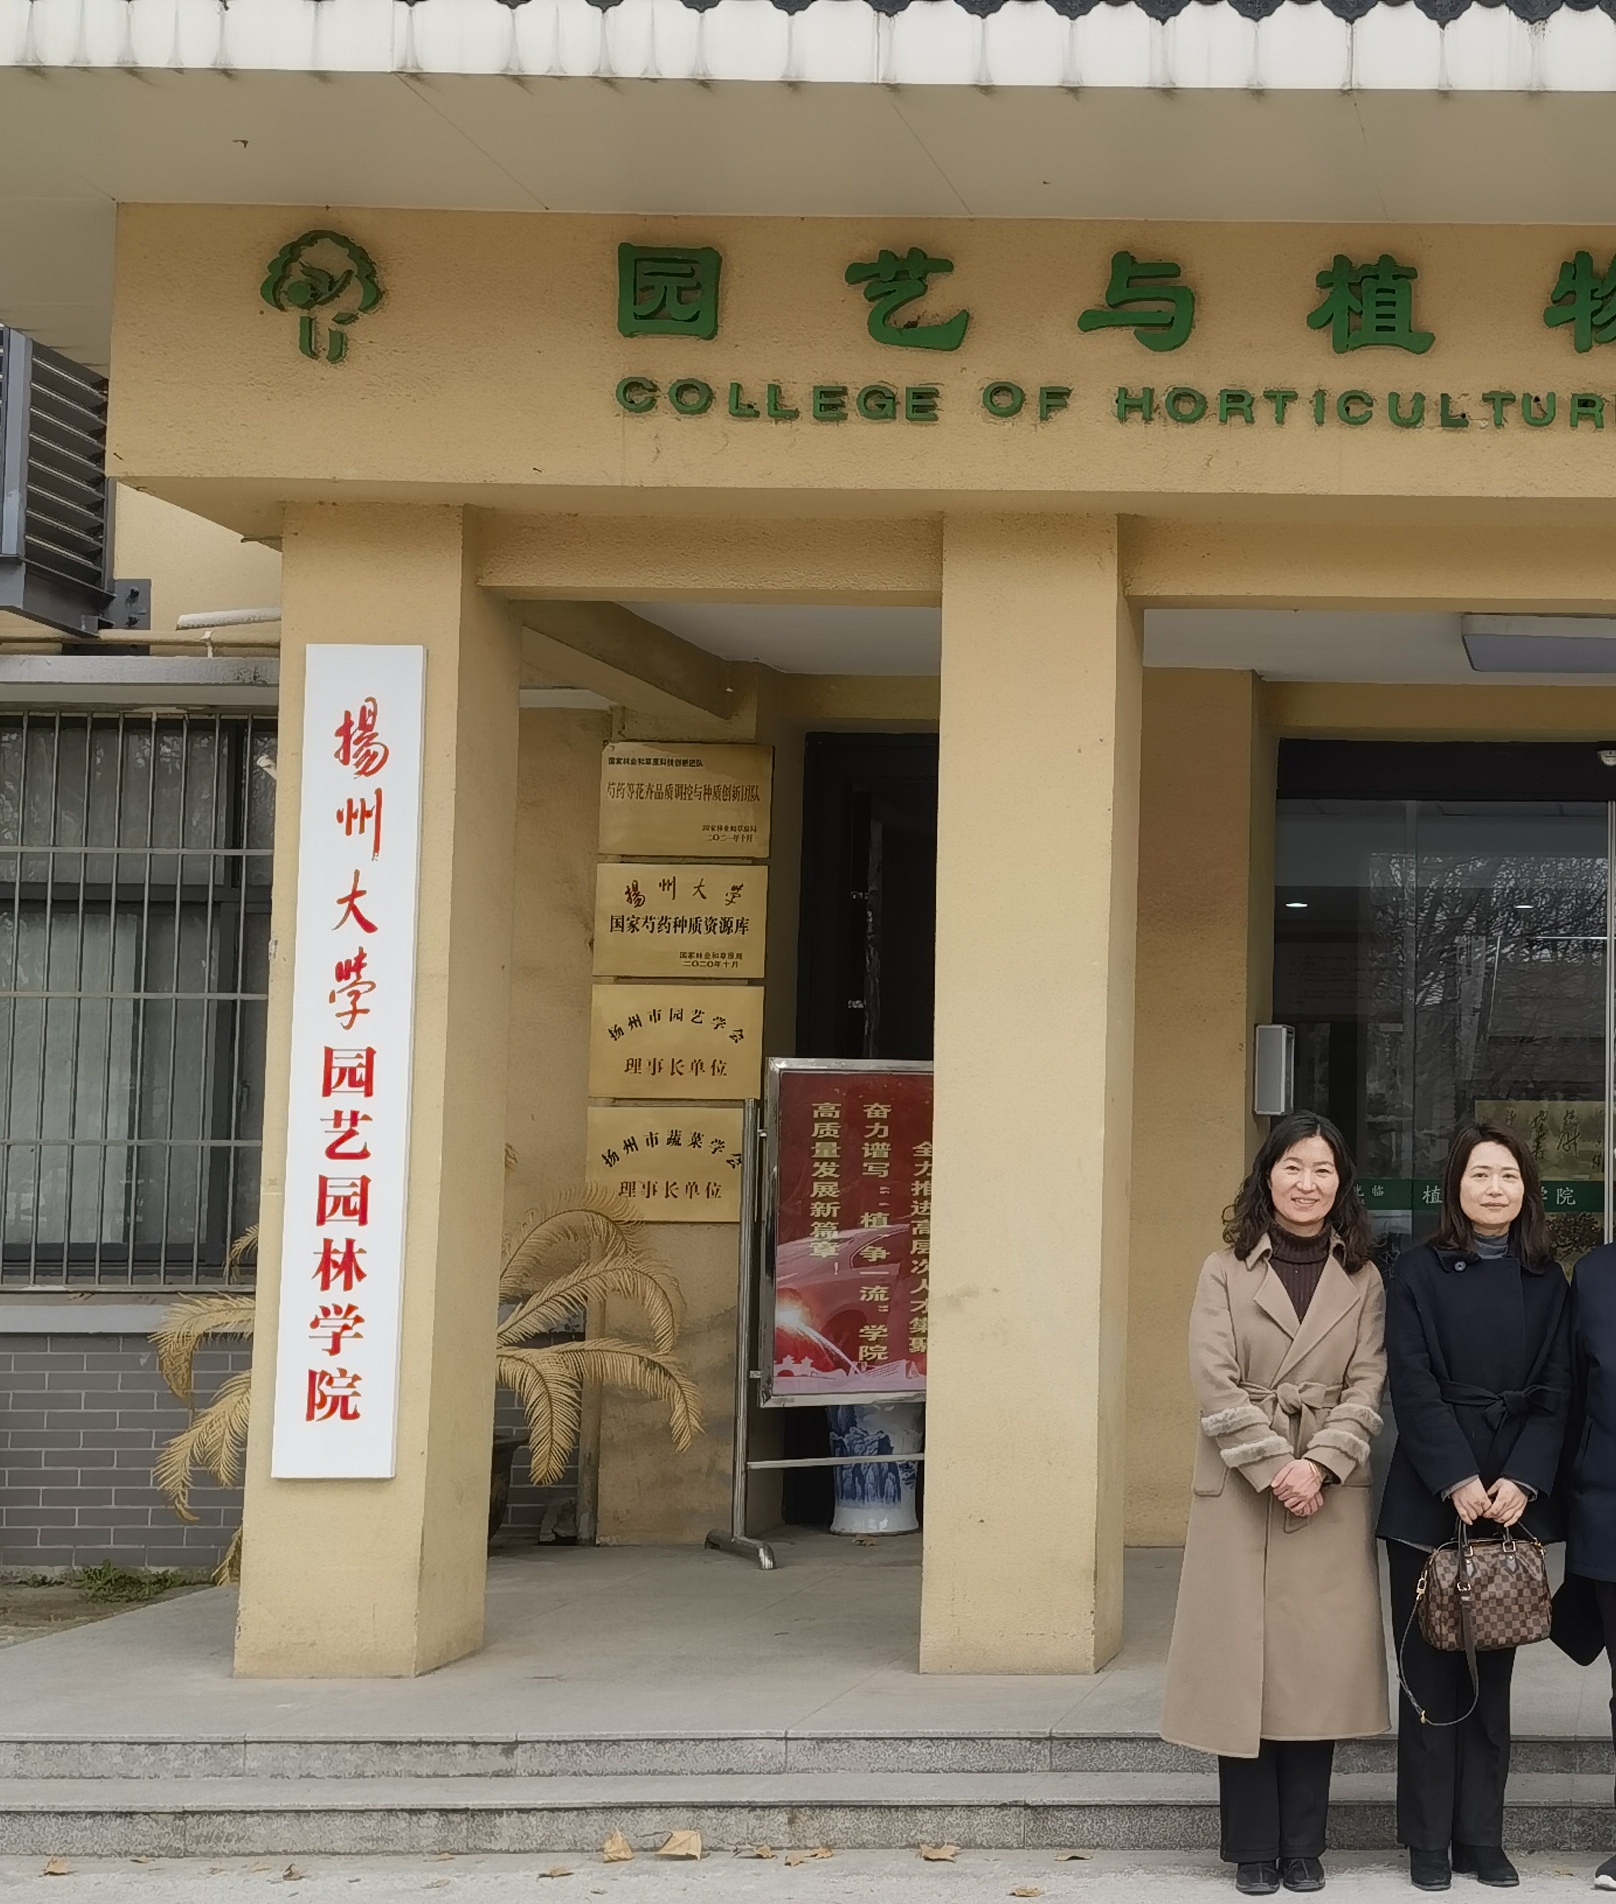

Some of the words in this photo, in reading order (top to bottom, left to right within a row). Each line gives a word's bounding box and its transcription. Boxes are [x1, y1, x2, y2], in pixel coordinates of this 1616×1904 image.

[616, 377, 939, 421] COLLEGE
[982, 381, 1072, 420] OF
[609, 914, 749, 935] 国家芍药种质资源库
[607, 1007, 745, 1044] 扬州市园艺学会
[624, 1057, 728, 1077] 理事长单位
[601, 1129, 742, 1169] 扬州市蔬菜学会
[618, 1181, 722, 1199] 理事长单位
